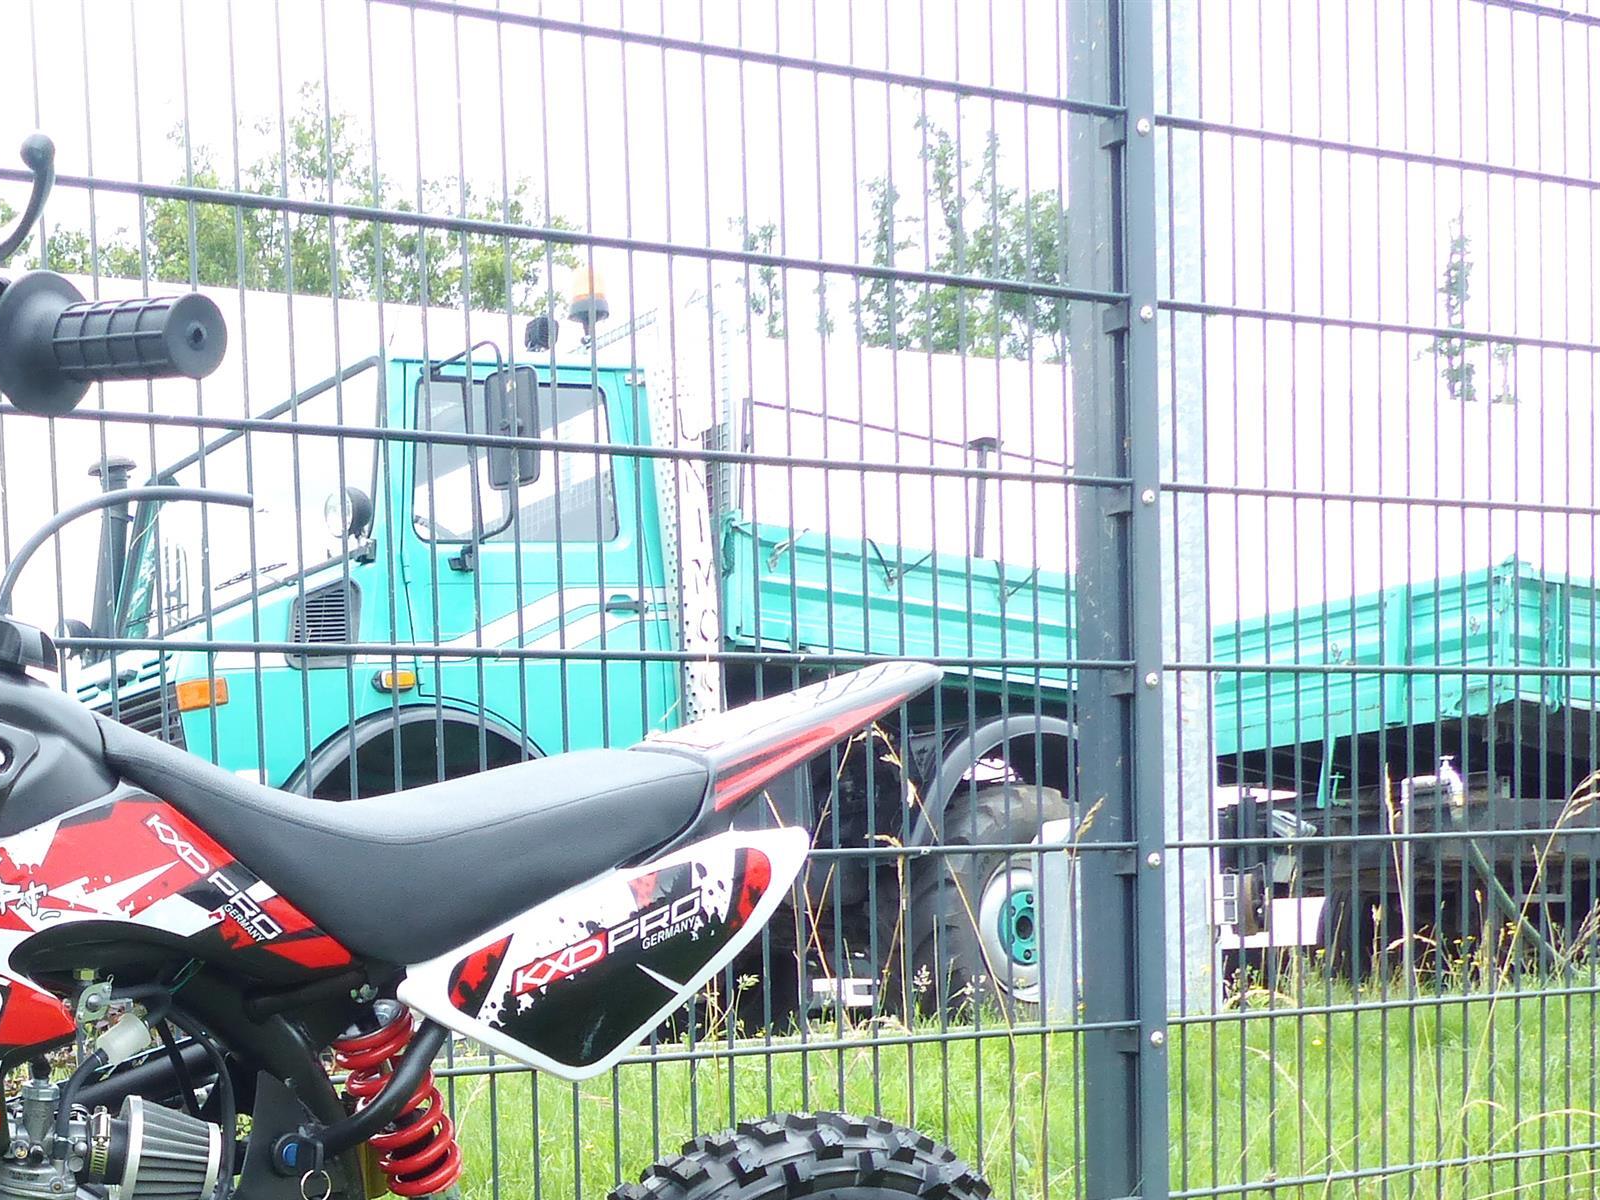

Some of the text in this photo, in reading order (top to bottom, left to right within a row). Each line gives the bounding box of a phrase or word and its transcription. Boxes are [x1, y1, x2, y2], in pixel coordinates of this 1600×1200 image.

[207, 870, 283, 940] PRO
[224, 902, 266, 943] GERMANY
[514, 889, 701, 993] KXD PRO
[641, 917, 698, 950] GERMANY
